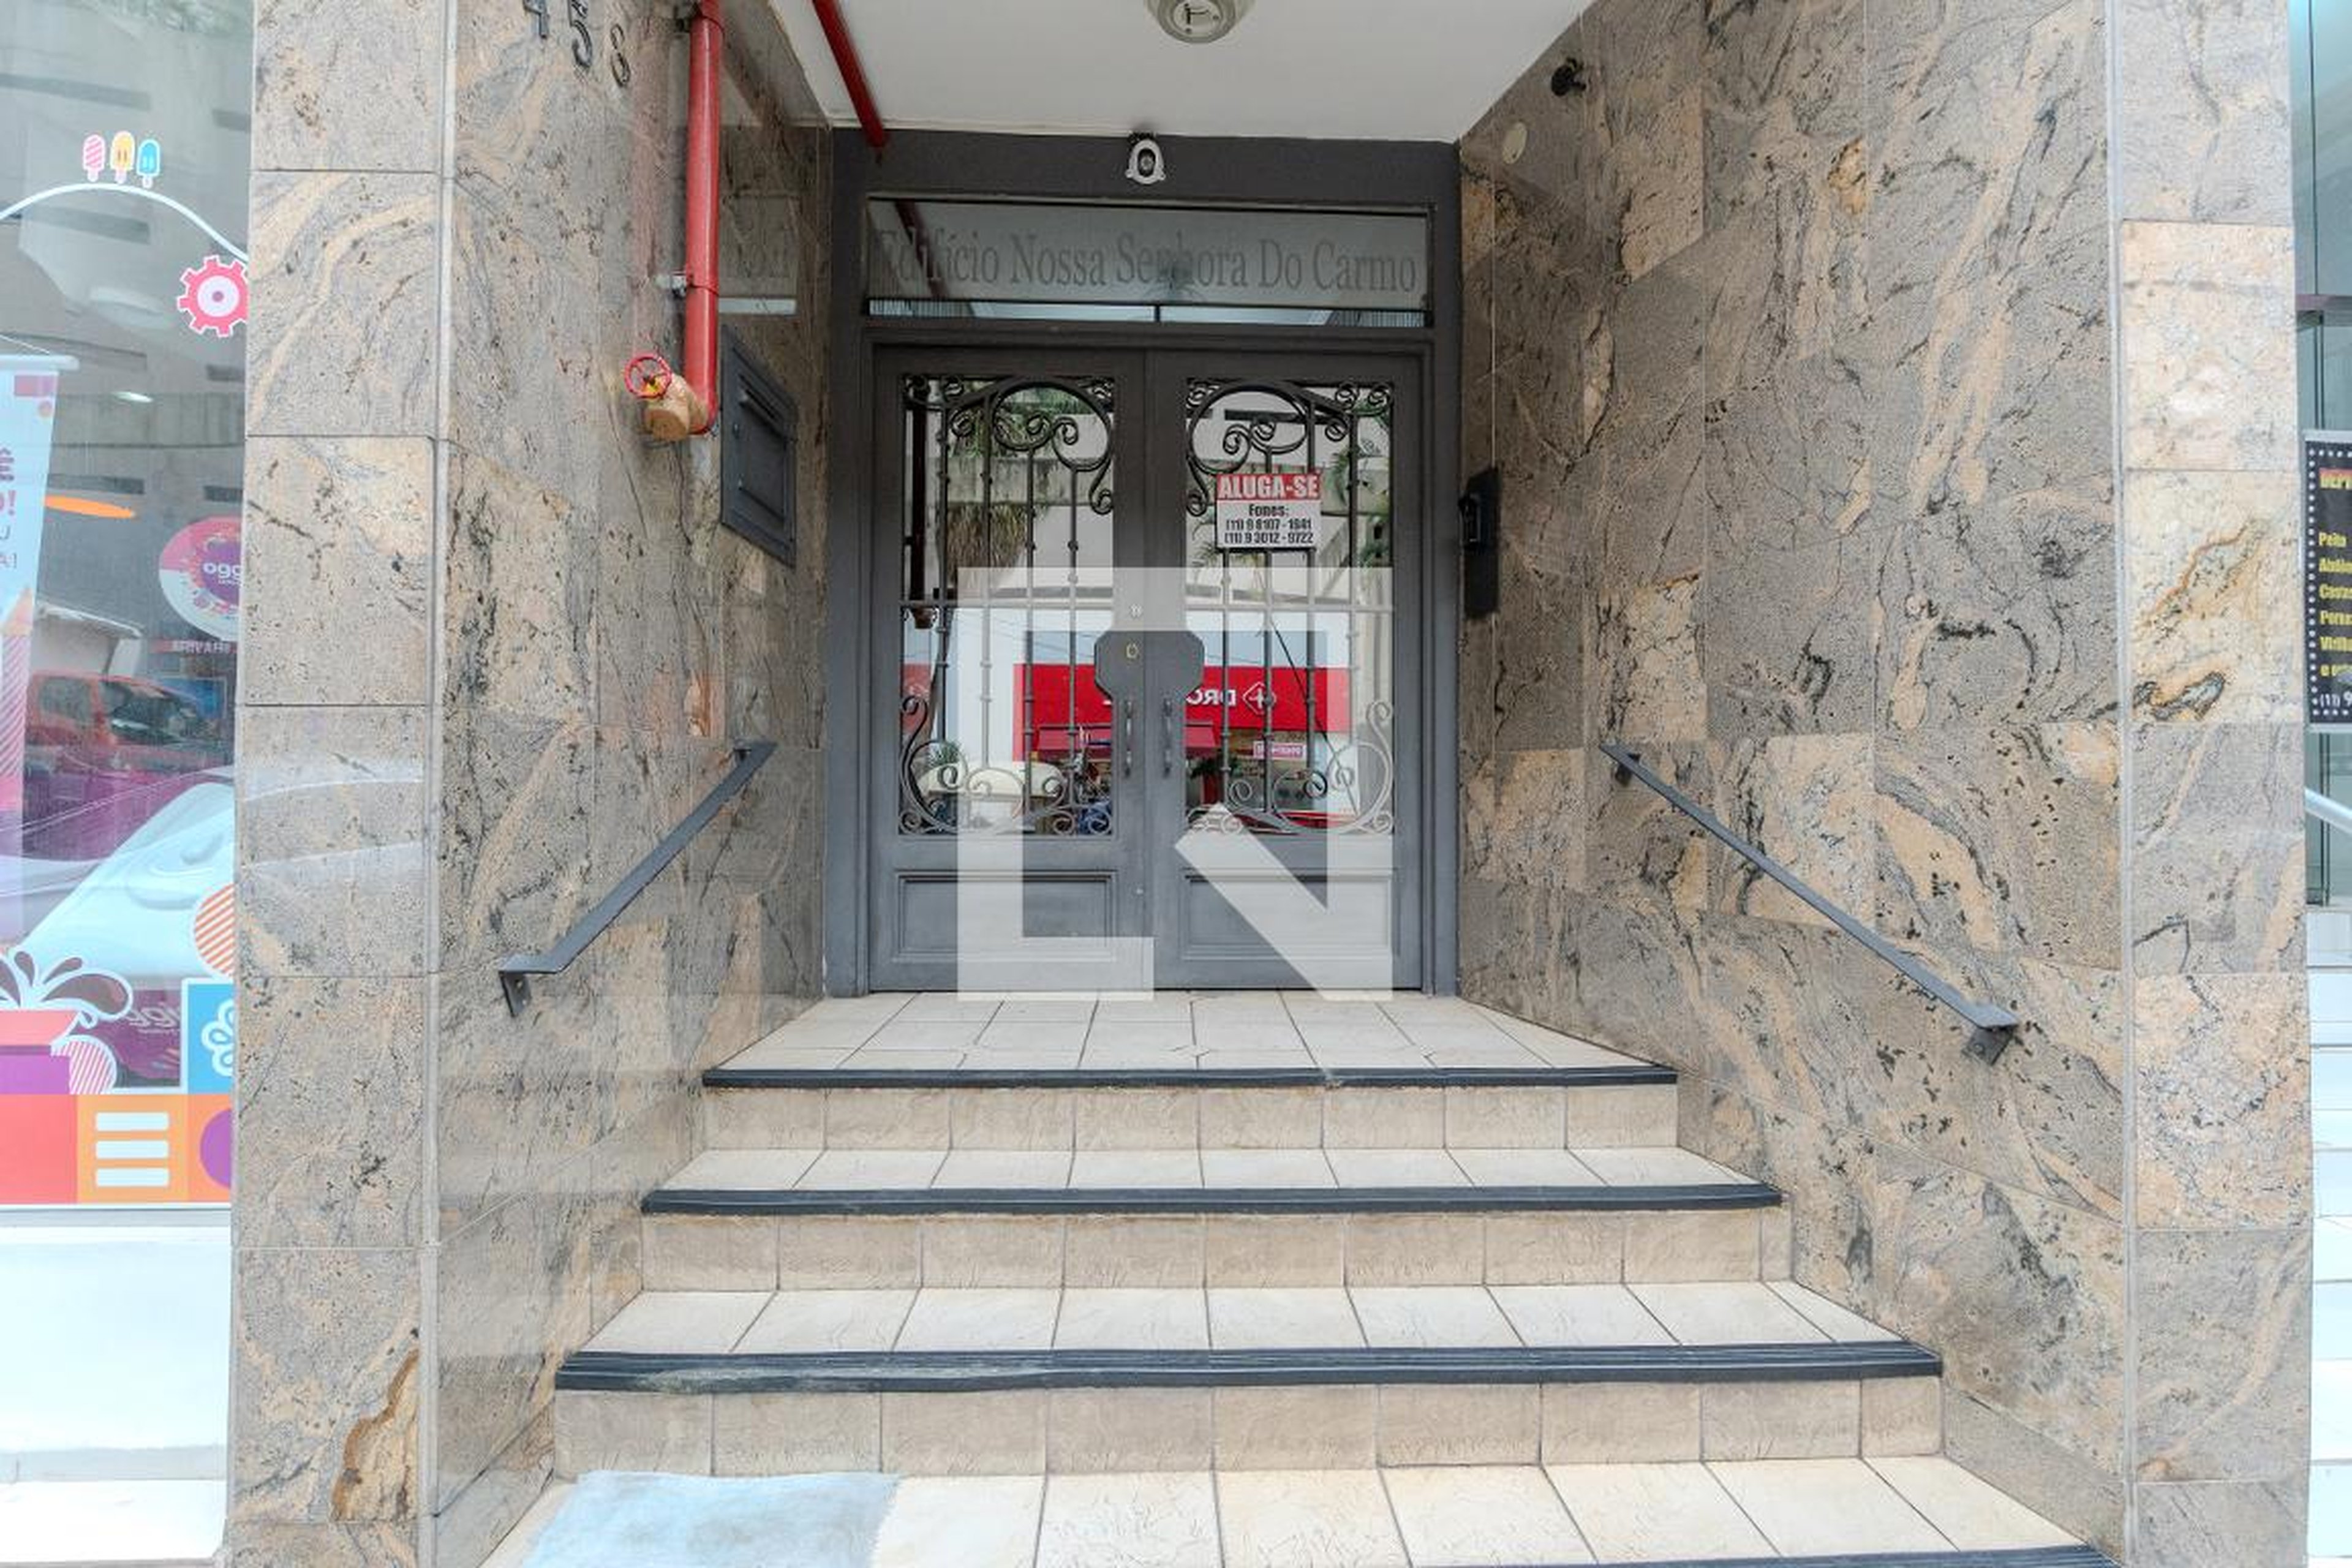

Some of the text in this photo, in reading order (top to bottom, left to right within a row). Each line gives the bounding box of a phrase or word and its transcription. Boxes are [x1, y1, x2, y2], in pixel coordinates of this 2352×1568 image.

[1011, 233, 1106, 286] Nossa
[1117, 228, 1247, 287] Senhora
[1258, 238, 1303, 290] Do
[1313, 239, 1416, 293] Carmo
[1218, 475, 1319, 498] ALUGA-SE
